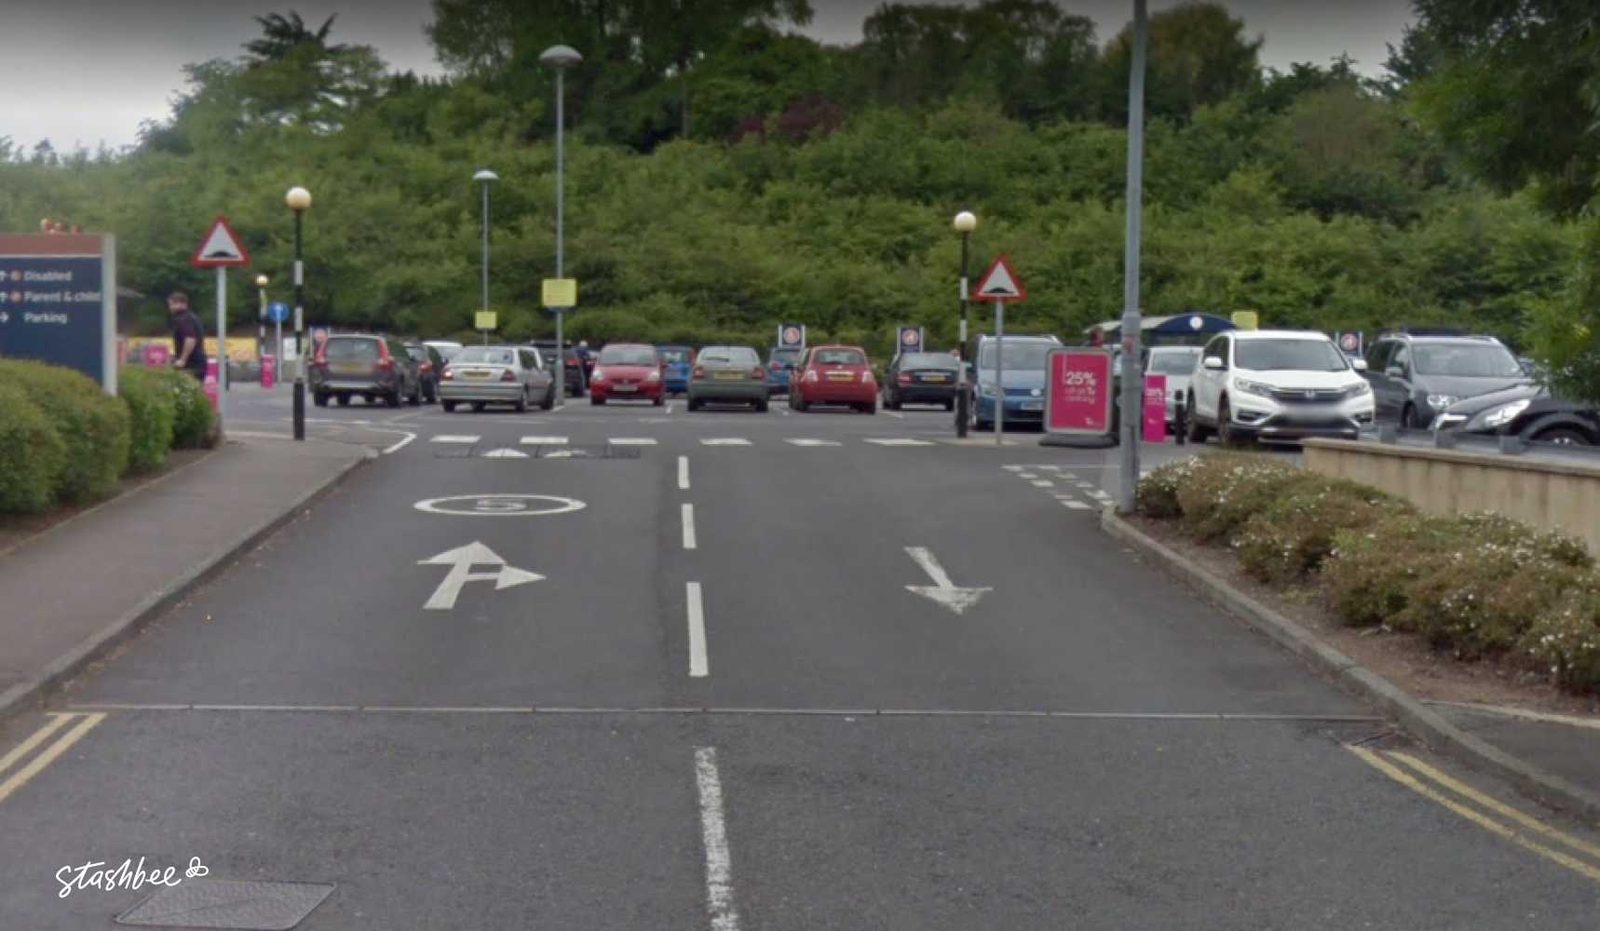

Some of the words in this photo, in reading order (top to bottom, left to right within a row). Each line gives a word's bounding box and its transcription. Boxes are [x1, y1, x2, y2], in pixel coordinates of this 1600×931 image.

[24, 271, 72, 281] Disabled
[24, 291, 61, 302] Parent
[63, 291, 72, 302] &
[75, 291, 101, 302] child
[24, 312, 68, 324] Parking
[1065, 371, 1096, 386] 25%
